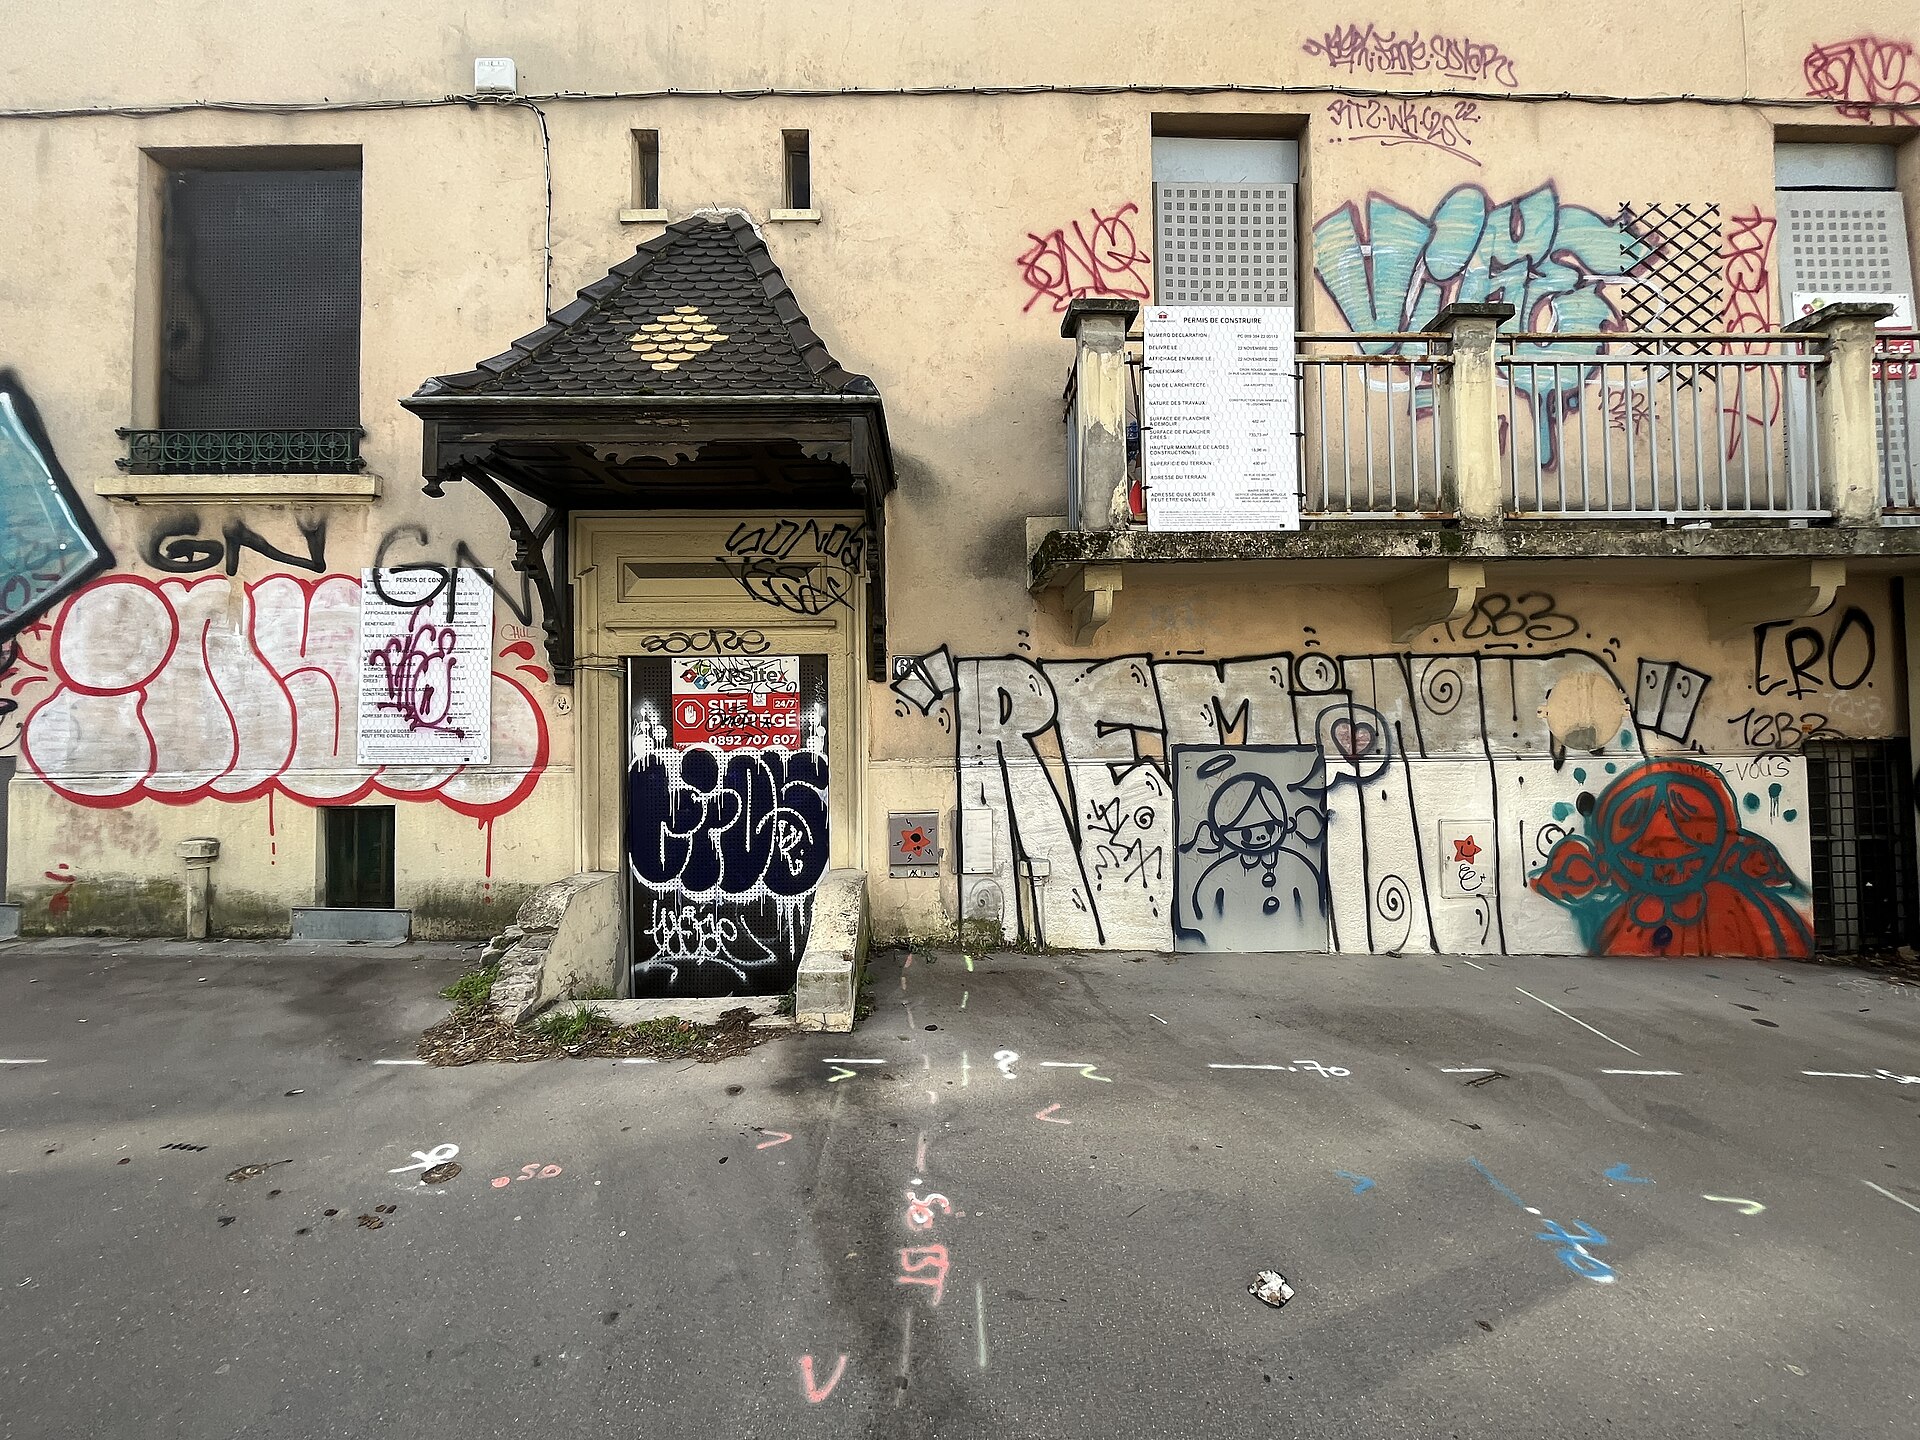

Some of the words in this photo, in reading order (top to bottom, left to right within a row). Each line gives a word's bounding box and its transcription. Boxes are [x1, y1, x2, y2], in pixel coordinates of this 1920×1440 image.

[708, 699, 749, 714] SITE
[775, 700, 796, 708] 24/7
[708, 735, 743, 746] 0892
[772, 734, 798, 746] 607
